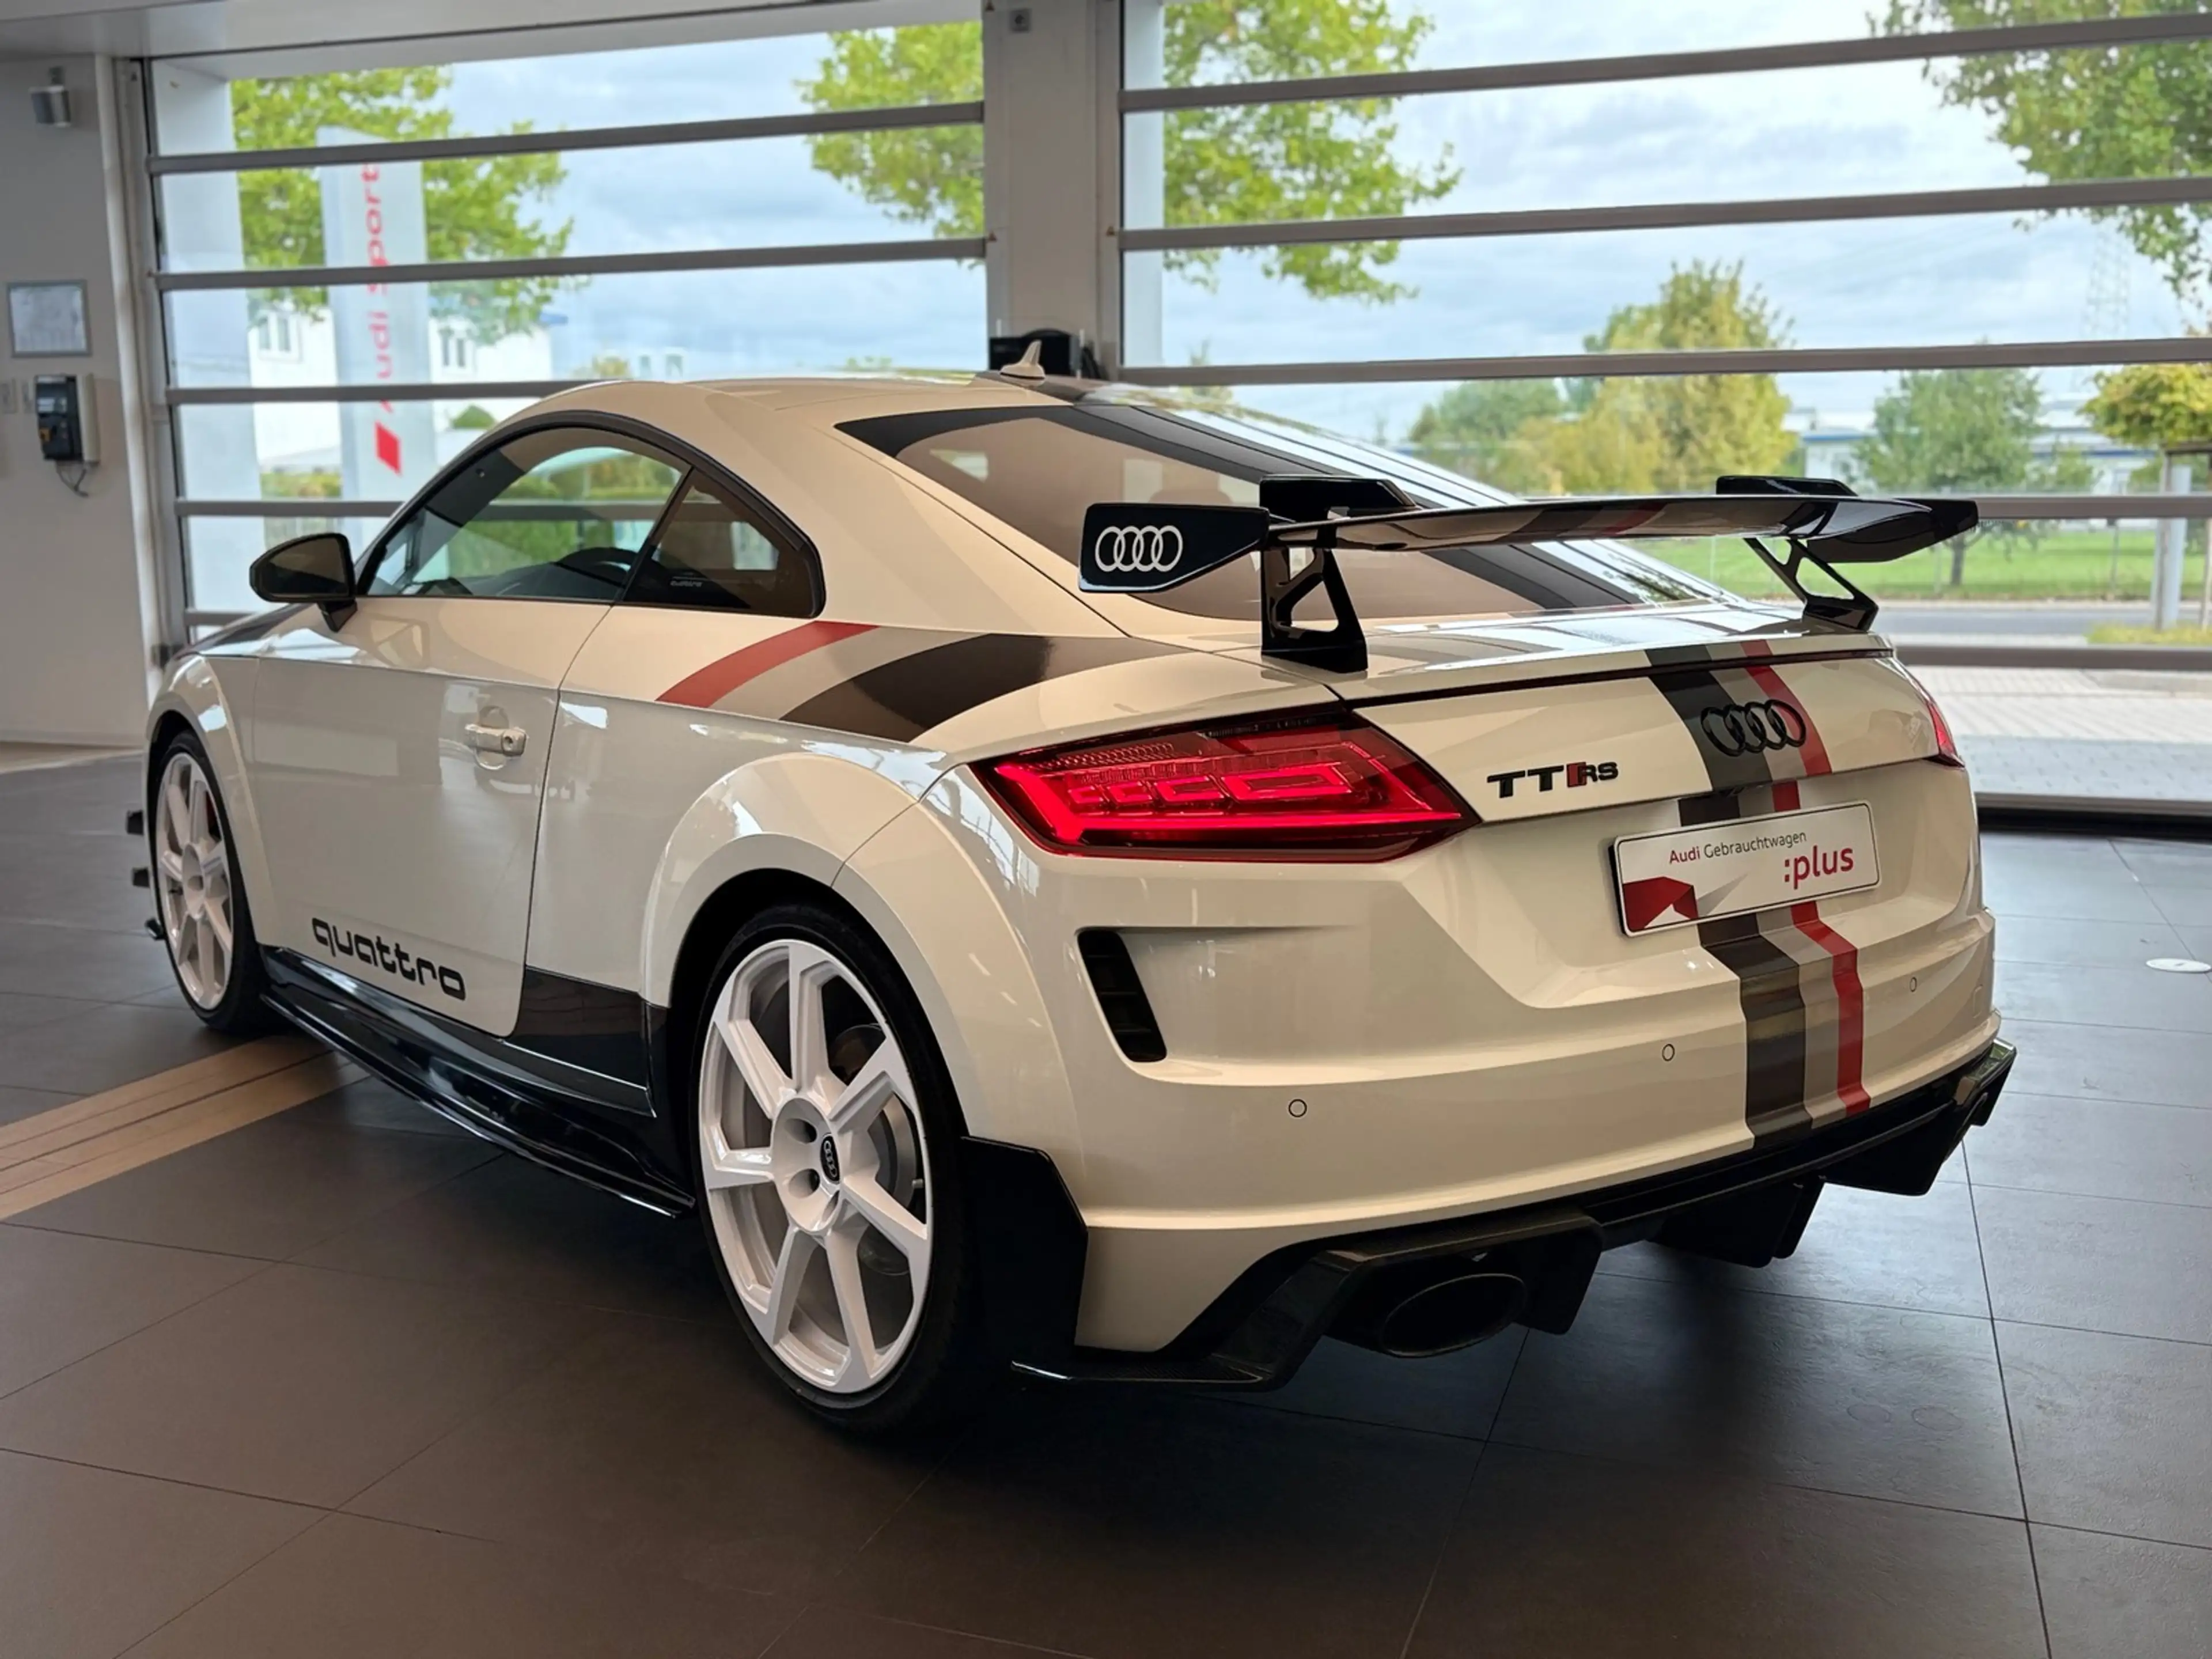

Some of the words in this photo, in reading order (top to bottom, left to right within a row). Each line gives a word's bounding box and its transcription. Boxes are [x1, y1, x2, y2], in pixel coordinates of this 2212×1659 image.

[1669, 846, 1701, 864] Audi
[1703, 831, 1808, 859] Gebrauchtwagen
[1784, 844, 1854, 890] :plus
[312, 917, 467, 1001] quattro
